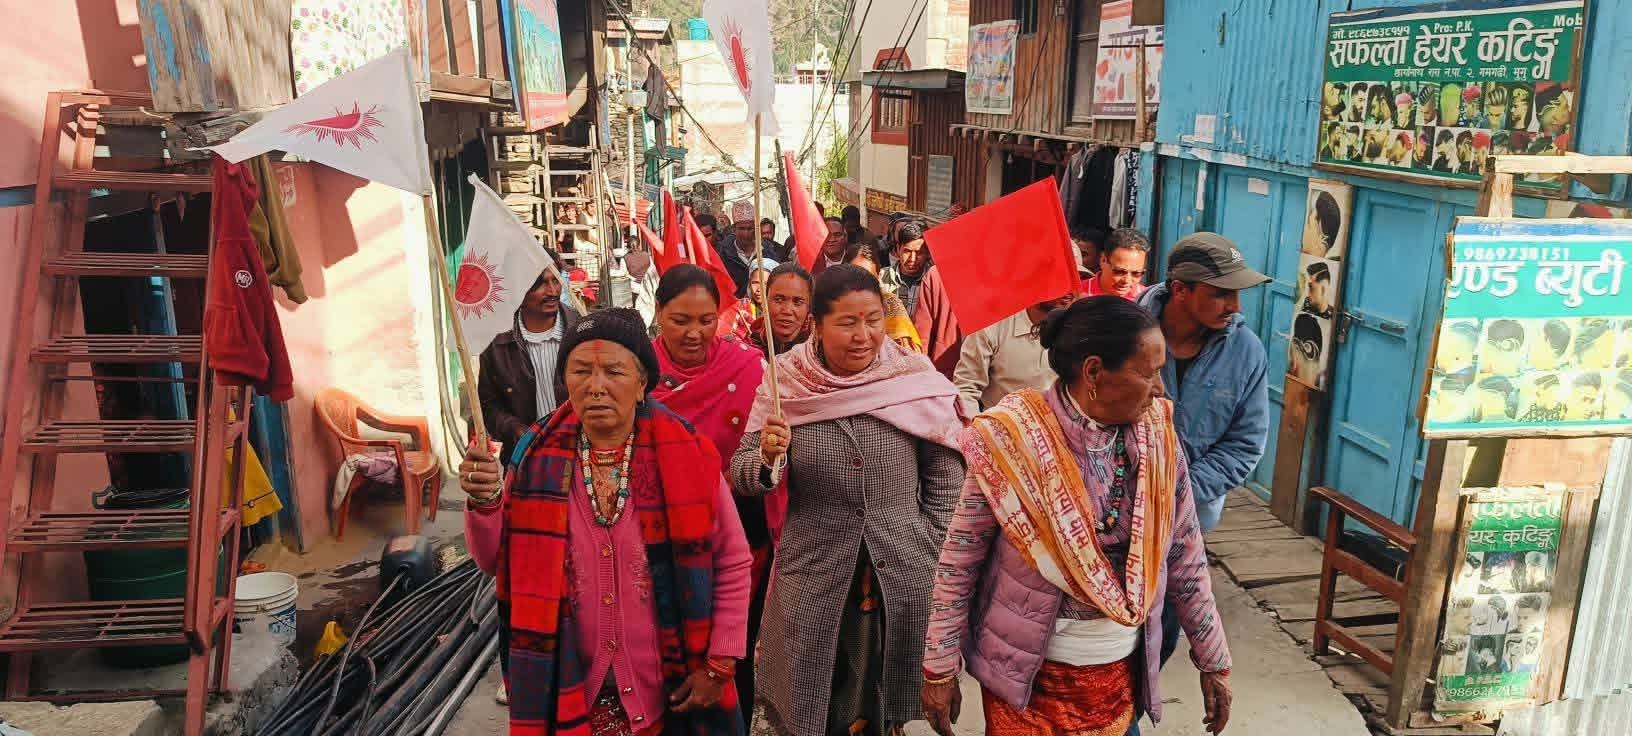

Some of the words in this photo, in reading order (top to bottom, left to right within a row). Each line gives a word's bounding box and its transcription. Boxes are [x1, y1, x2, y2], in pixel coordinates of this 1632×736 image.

[1434, 22, 1453, 33] Pro:
[1455, 20, 1474, 32] P.K.
[1330, 36, 1410, 68] सफल्ता
[1413, 25, 1472, 67] हेयर
[1463, 247, 1570, 261] 9869738151
